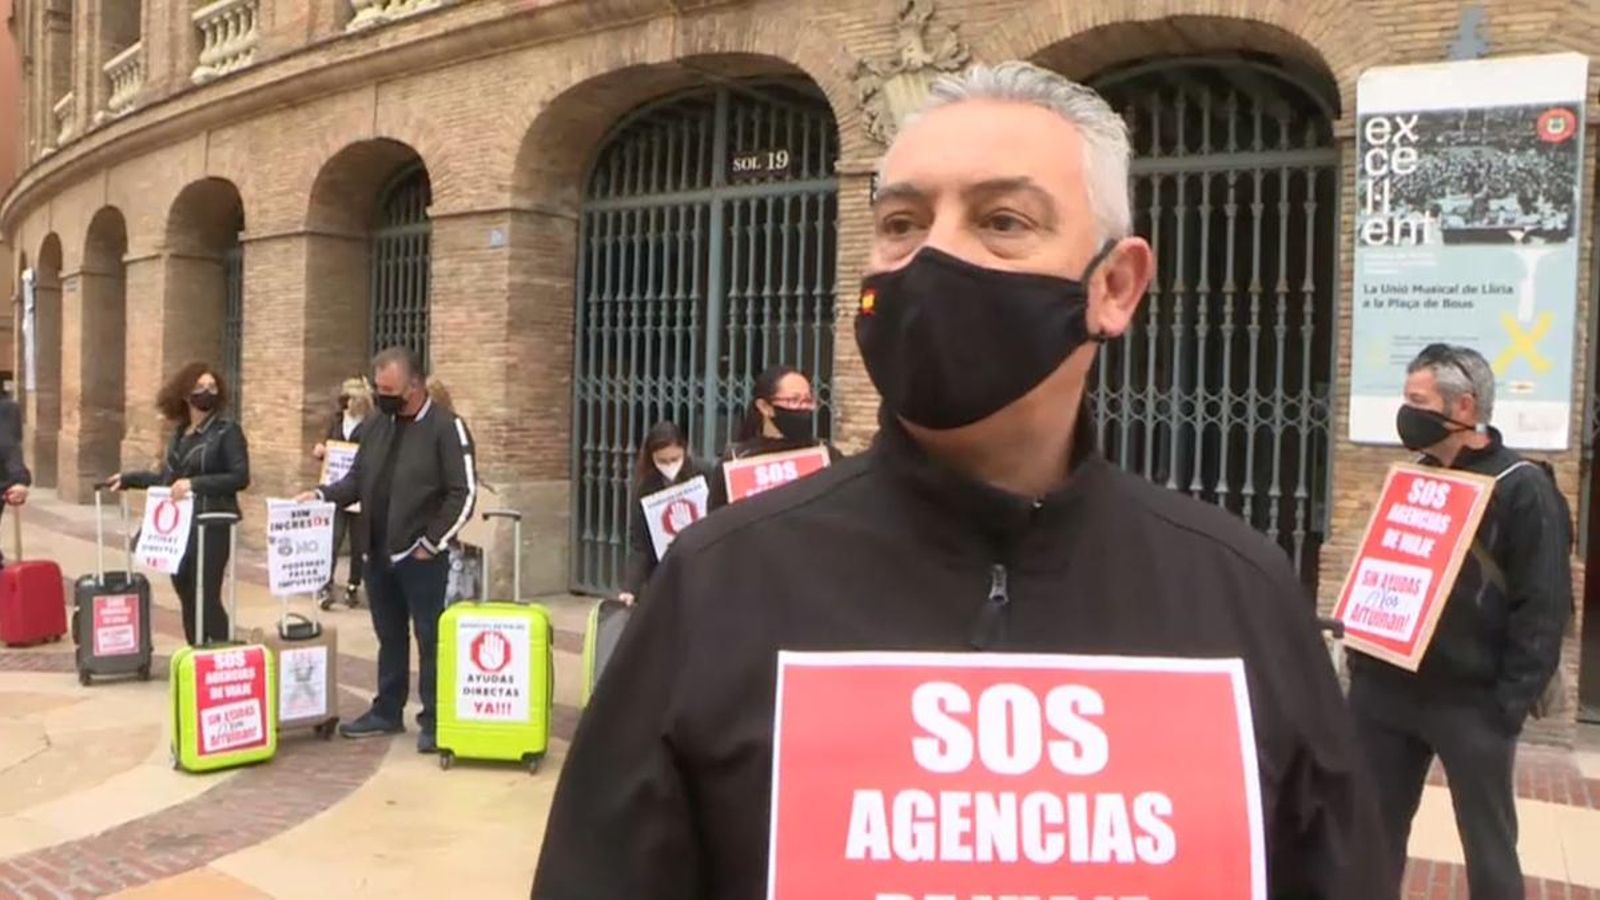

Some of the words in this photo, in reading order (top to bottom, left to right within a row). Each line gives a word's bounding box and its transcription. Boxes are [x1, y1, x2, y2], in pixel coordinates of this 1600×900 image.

[1364, 114, 1419, 145] ex
[733, 156, 762, 171] SOL
[768, 149, 789, 170] 19
[1364, 146, 1418, 176] ce
[1363, 284, 1377, 294] La
[1412, 284, 1459, 294] Musical
[1462, 284, 1478, 294] de
[1362, 300, 1370, 308] a
[1373, 298, 1385, 308] la
[1387, 299, 1420, 310] Plaça
[1423, 299, 1439, 308] de
[1442, 299, 1475, 309] Bous
[754, 460, 798, 485] SOS
[1407, 478, 1451, 510] SOS
[270, 516, 330, 531] INGRESOS
[1386, 503, 1452, 535] AGENCIAS
[1361, 569, 1379, 588] SIN
[467, 674, 514, 684] AYUDAS
[463, 687, 519, 697] DIRECTAS
[474, 702, 512, 715] YA!!!
[911, 681, 1109, 776] SOS
[845, 788, 1177, 865] AGENCIAS
